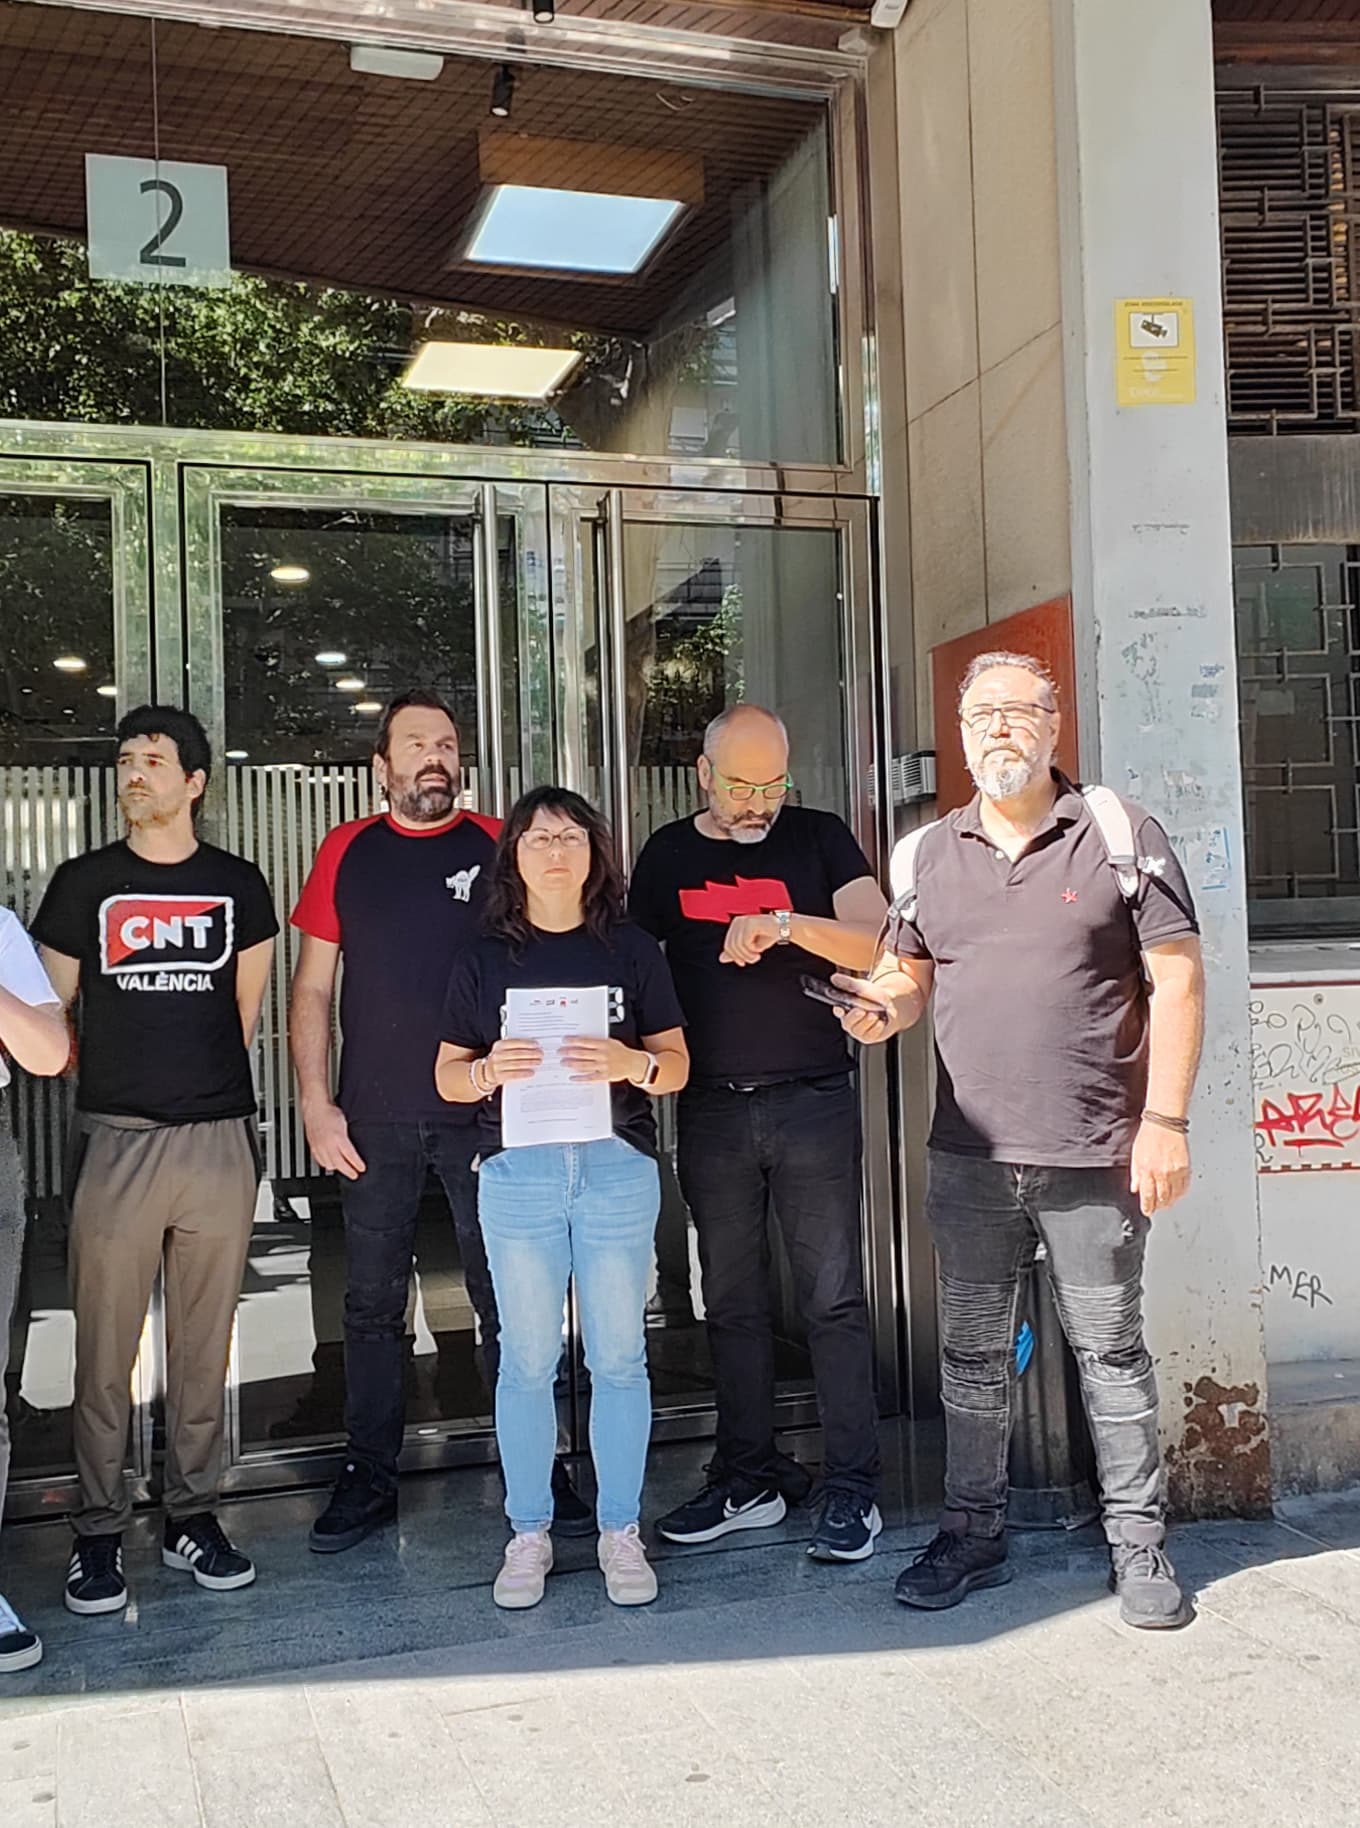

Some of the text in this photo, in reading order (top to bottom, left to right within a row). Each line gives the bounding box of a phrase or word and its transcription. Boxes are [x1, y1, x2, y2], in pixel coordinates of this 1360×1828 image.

[140, 179, 184, 268] 2
[120, 915, 214, 949] CNT
[116, 971, 215, 992] VALÈNCIA
[1269, 1264, 1334, 1309] MER
